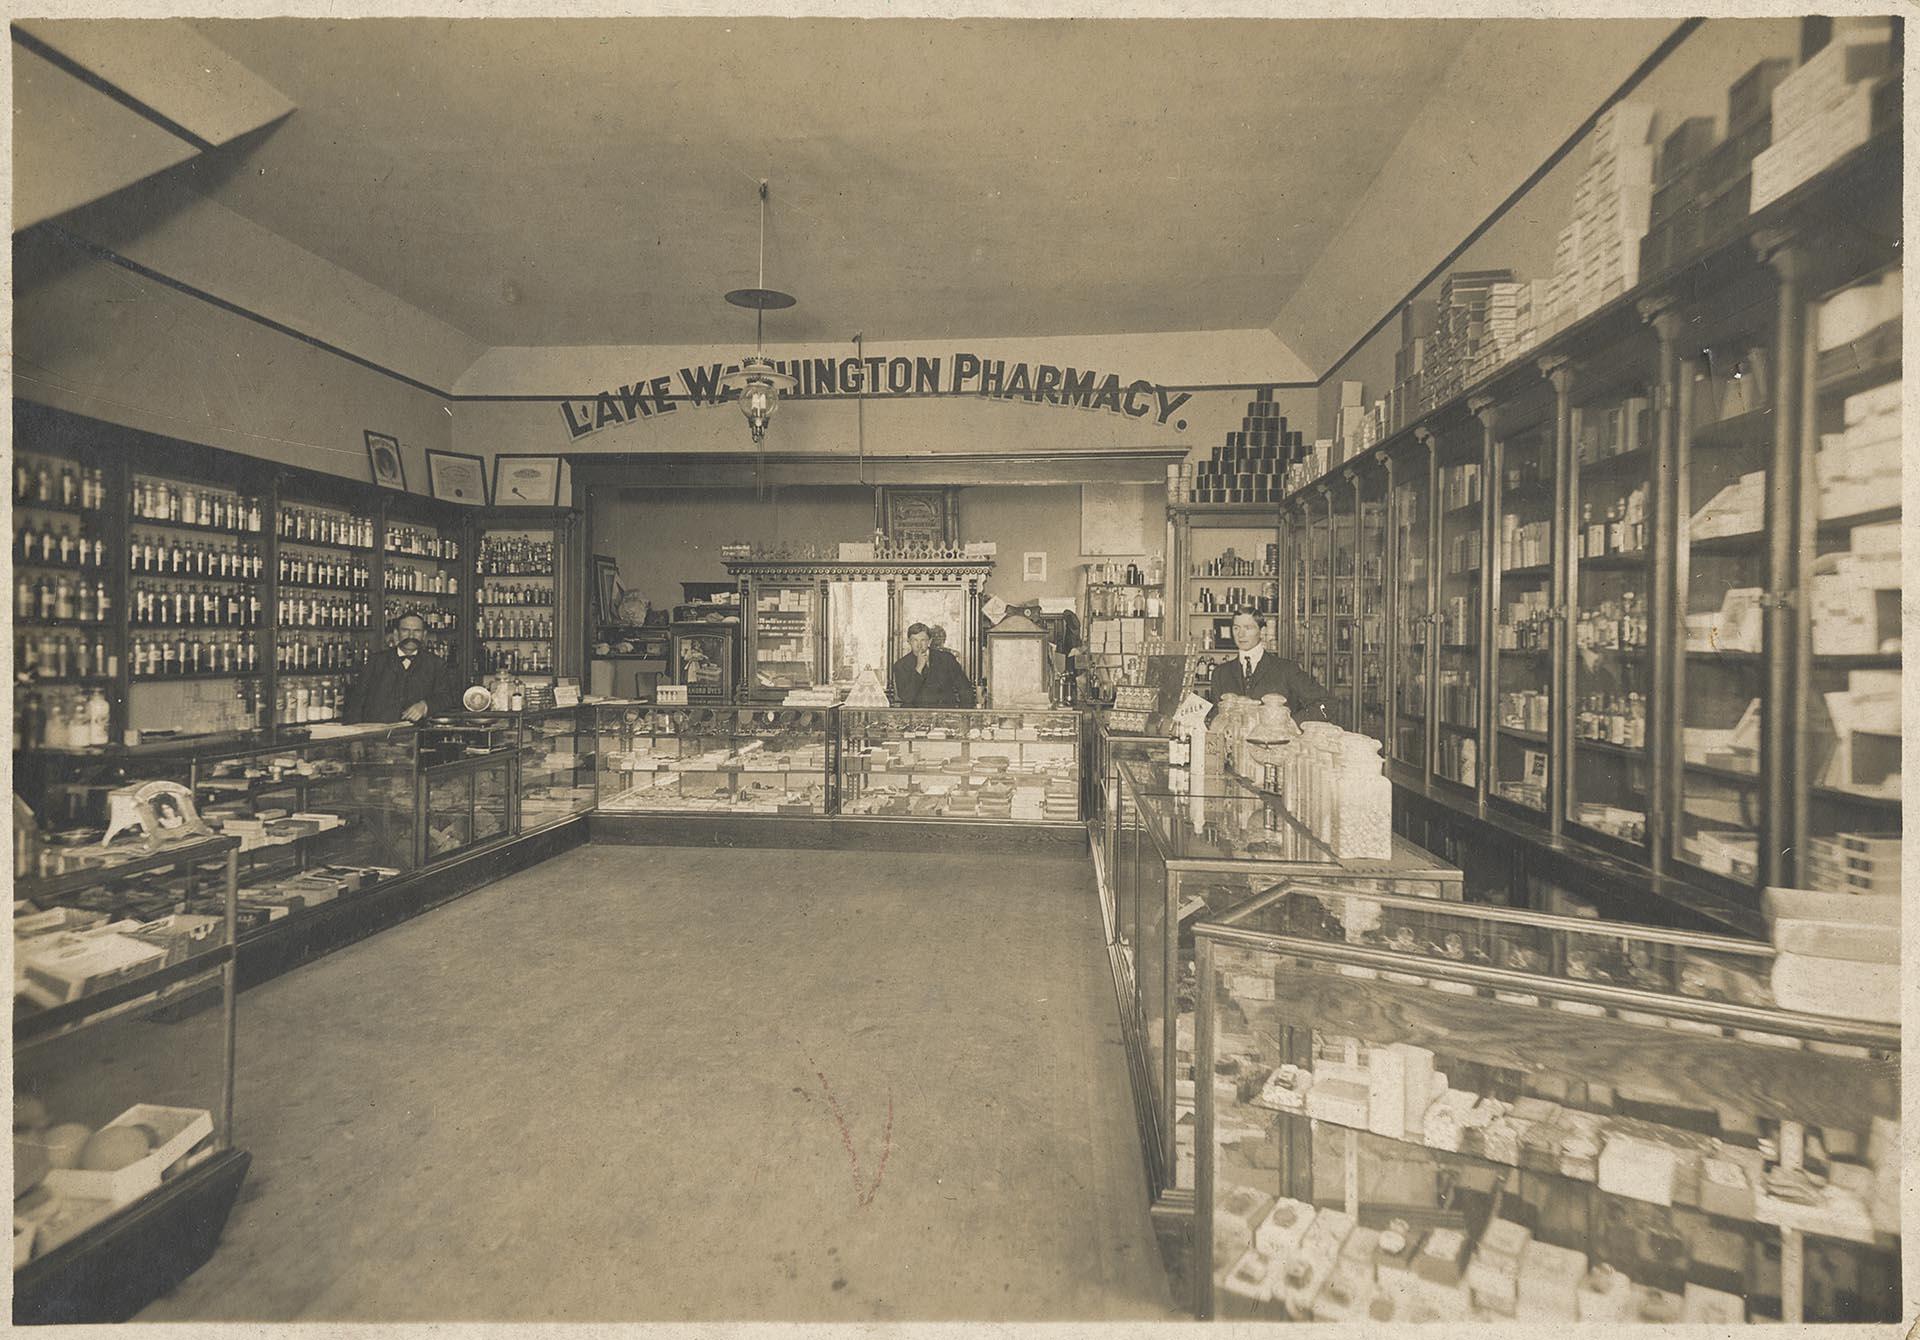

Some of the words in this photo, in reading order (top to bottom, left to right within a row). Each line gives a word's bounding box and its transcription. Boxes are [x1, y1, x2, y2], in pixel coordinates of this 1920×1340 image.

[561, 375, 677, 438] LAKE
[680, 356, 941, 407] WAHINGTON
[952, 353, 1193, 430] PHARMACY.
[1181, 704, 1204, 717] CHALK
